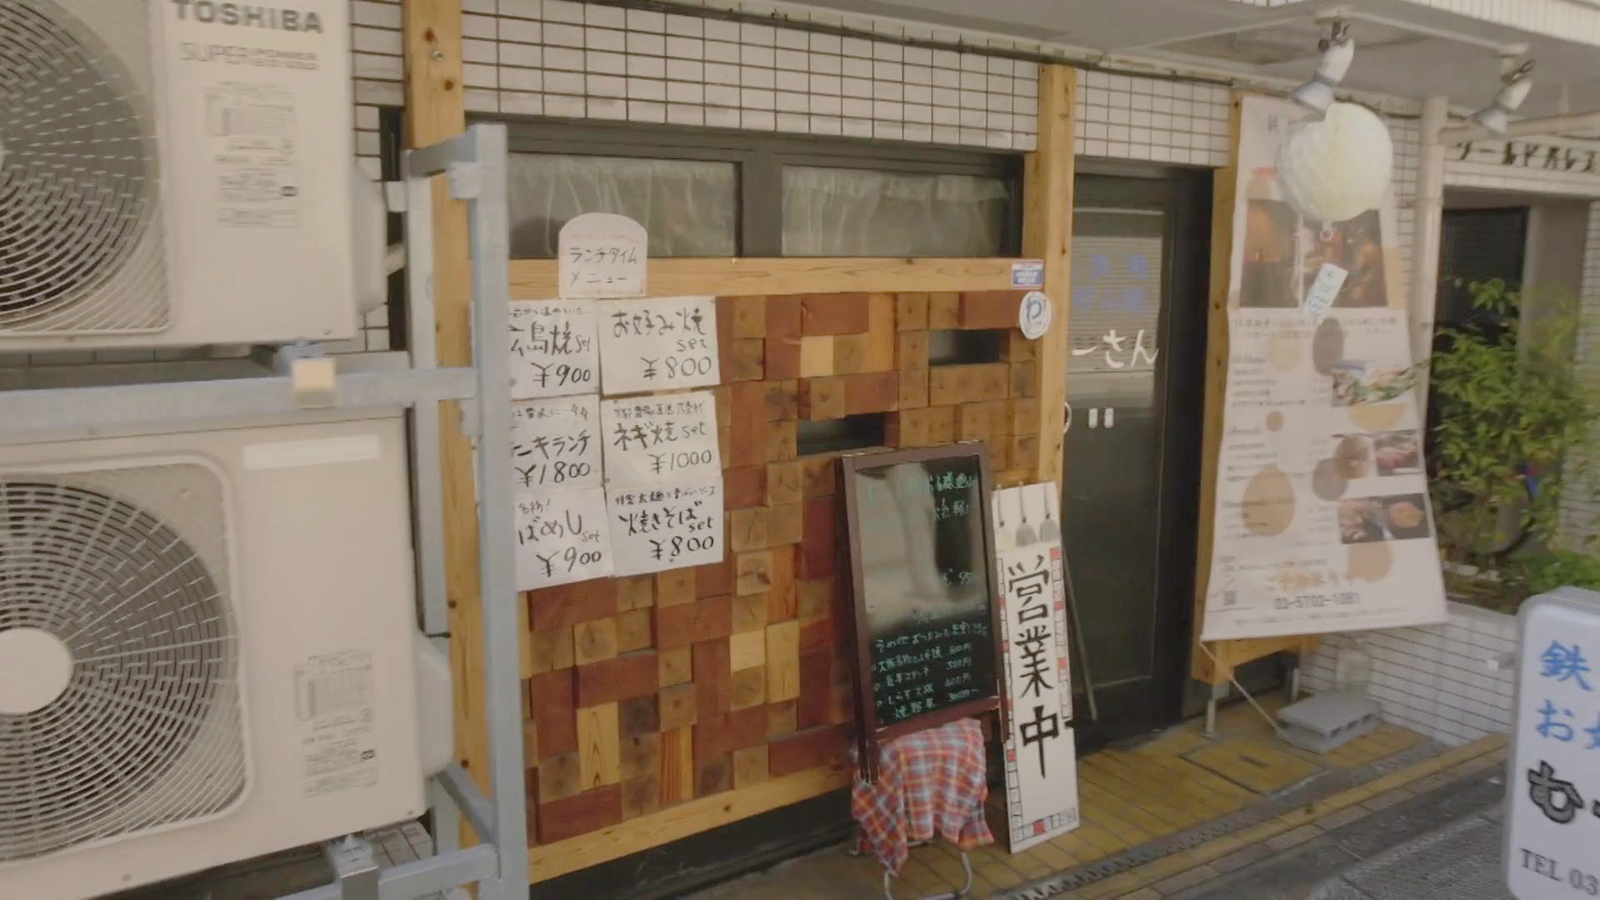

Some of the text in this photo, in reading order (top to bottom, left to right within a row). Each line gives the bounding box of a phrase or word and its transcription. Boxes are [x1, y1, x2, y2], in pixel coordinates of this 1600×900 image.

[171, 0, 324, 33] TOSHIBA
[568, 246, 638, 265] ランチタイム
[569, 270, 628, 286] メニュー
[611, 308, 706, 337] お好み焼
[530, 362, 592, 388] ¥900
[640, 356, 712, 381] ¥800
[613, 421, 678, 451] ネギ焼
[514, 461, 591, 487] ¥1800
[647, 449, 712, 474] ¥1000
[619, 501, 703, 536] 焼きそば
[536, 546, 602, 578] ¥900
[648, 535, 714, 561] ¥800
[1008, 553, 1060, 779] 営業中
[1540, 640, 1594, 692] 鉄
[1520, 847, 1563, 882] TEL
